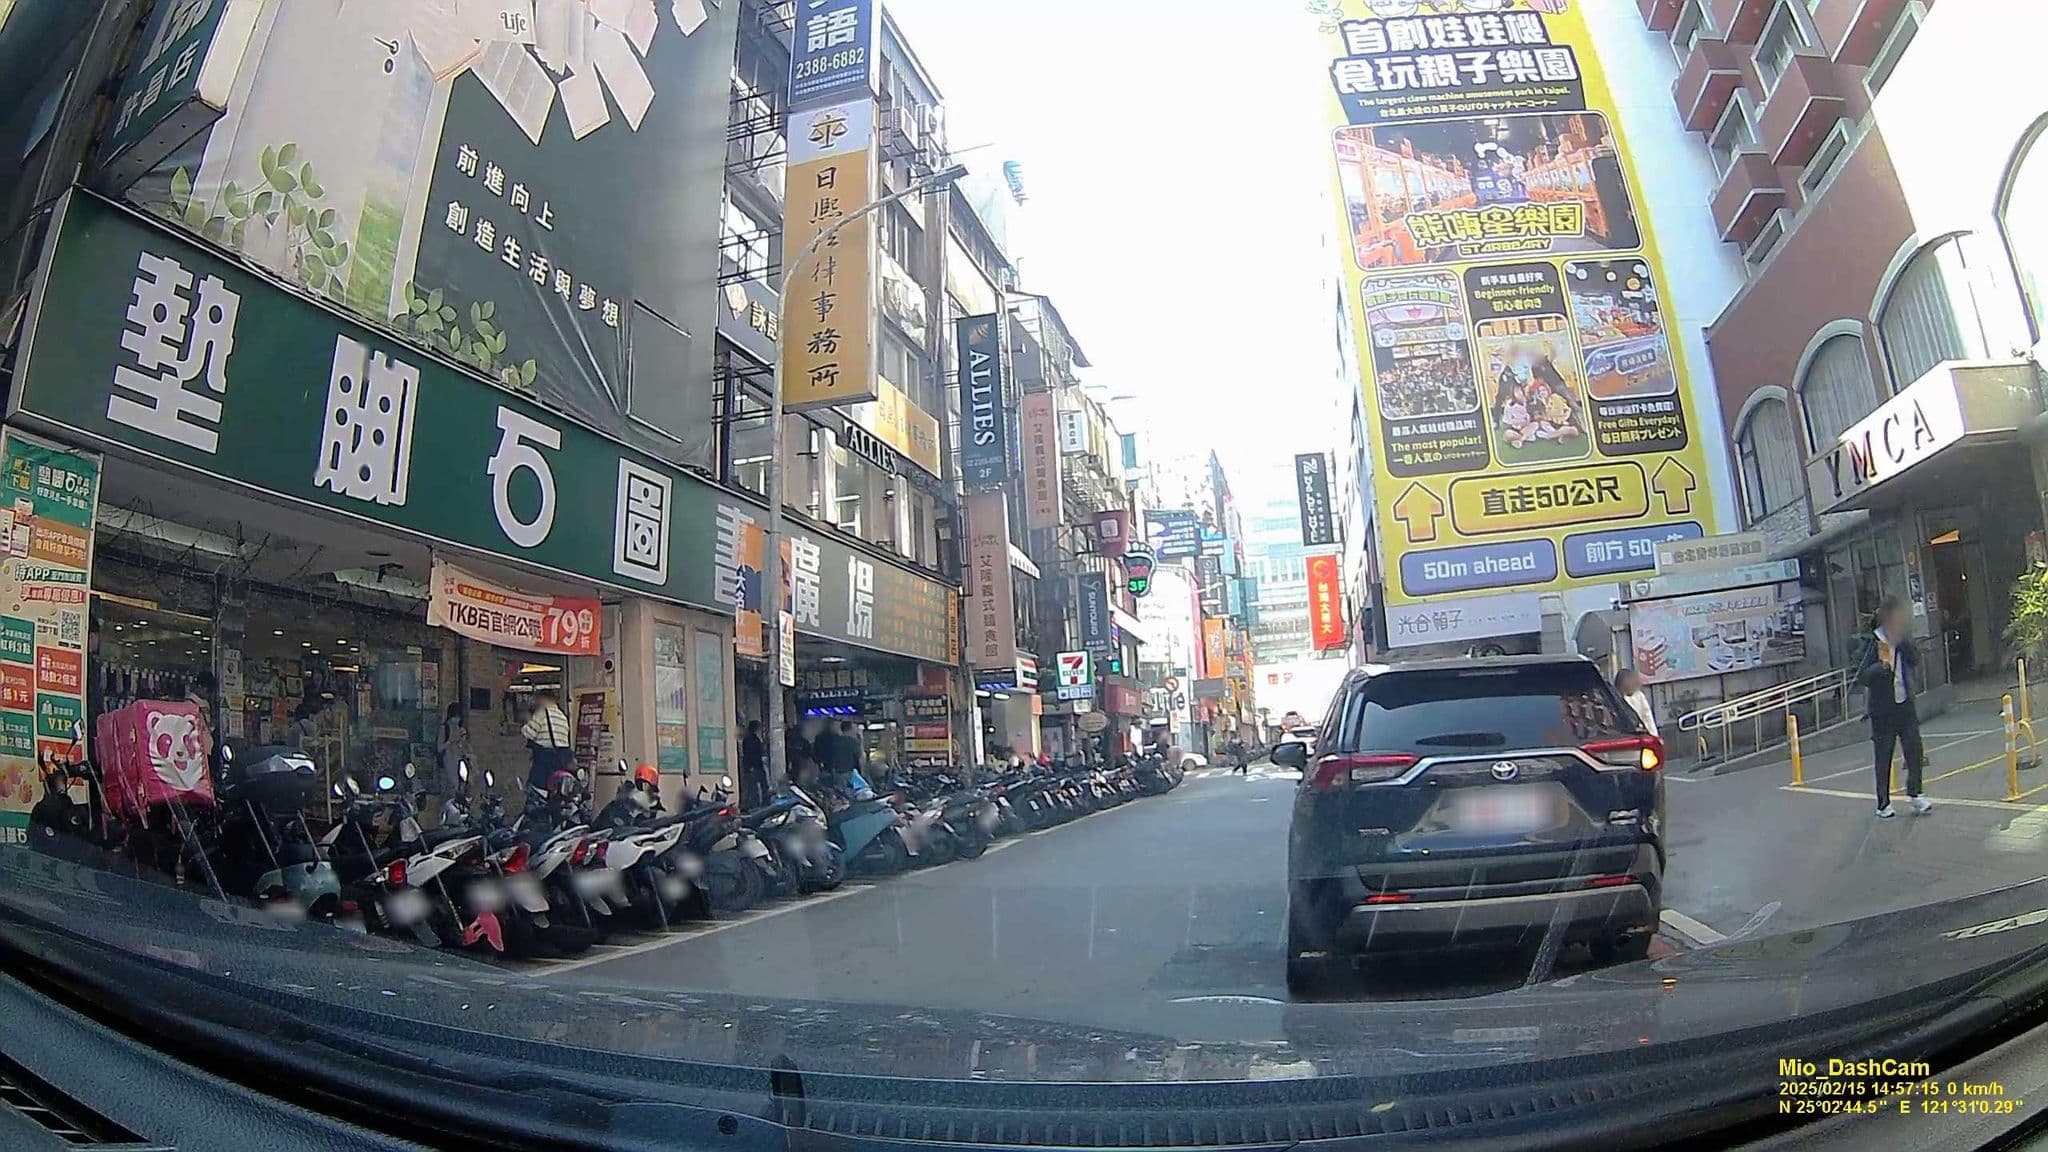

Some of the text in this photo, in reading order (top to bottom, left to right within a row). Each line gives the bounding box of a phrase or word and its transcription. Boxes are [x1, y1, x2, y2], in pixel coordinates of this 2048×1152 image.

[500, 11, 526, 32] Life
[806, 0, 858, 53] 語
[1343, 13, 1547, 55] 首創娃娃機
[795, 47, 865, 79] 2388-6882
[1332, 48, 1578, 93] 食玩親子樂園
[455, 144, 554, 231] 前進向上
[445, 200, 620, 328] 創造生活與夢想
[969, 350, 996, 447] ALLIES
[1598, 420, 1617, 430] Free
[847, 424, 897, 475] ALLIES
[1391, 435, 1482, 452] The most popular!
[1823, 398, 1936, 499] YMCA
[979, 468, 992, 479] 2F
[1481, 476, 1622, 517] 直走50公尺
[1423, 551, 1536, 581] 50m ahead
[1584, 542, 1625, 564] 前方
[1128, 580, 1147, 592] 3F
[48, 717, 73, 732] VIP
